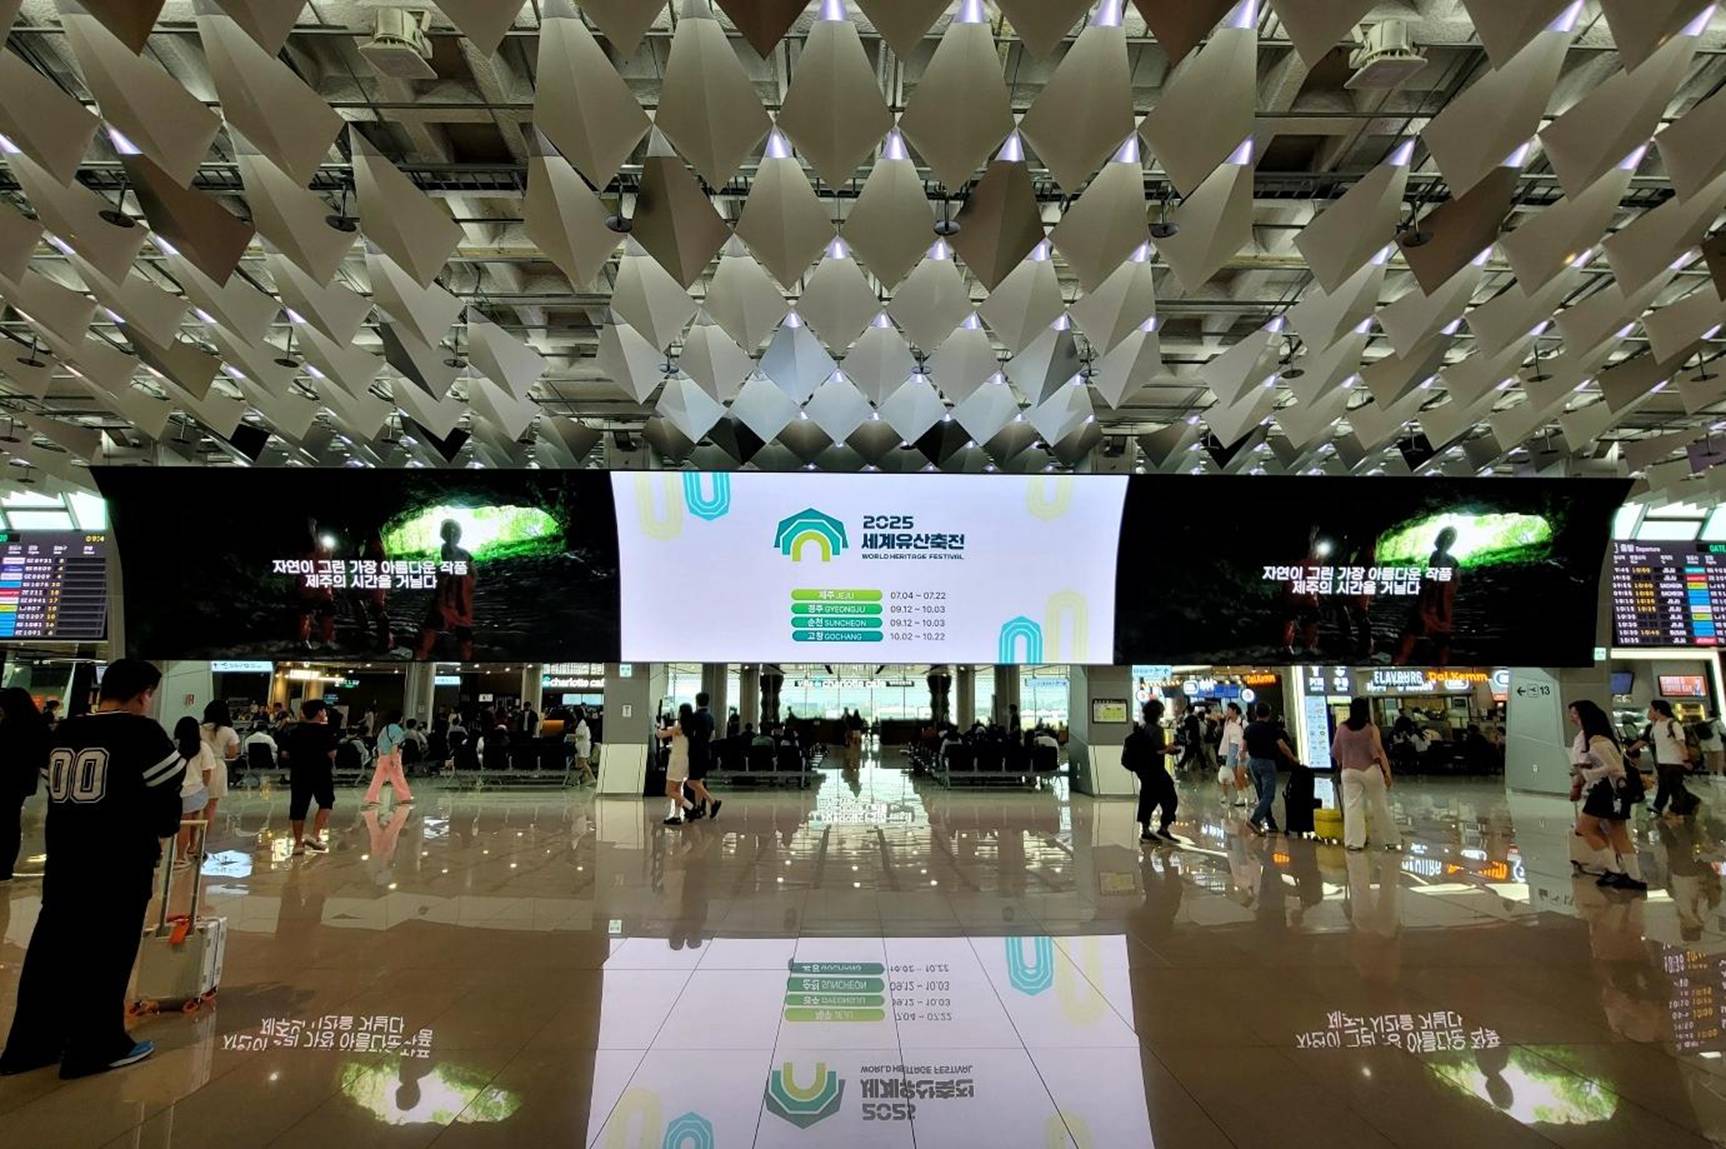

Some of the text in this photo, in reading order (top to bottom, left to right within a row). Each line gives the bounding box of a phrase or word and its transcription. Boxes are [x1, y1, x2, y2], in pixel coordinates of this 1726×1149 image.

[863, 515, 914, 529] 2025
[861, 533, 965, 550] 세계유산축전
[272, 560, 468, 575] 자연이 그린 가장 아름다운 작품
[1262, 566, 1452, 581] 자연이 그린 가장 아름다운 작품
[305, 575, 438, 589] 제주의 시간을 거닐다
[1292, 581, 1421, 595] 제주의 시간을 거닐다
[835, 592, 854, 600] JEJU
[890, 591, 914, 600] 07.04
[923, 591, 946, 600] 07.22
[824, 605, 866, 613] GYEONGJU
[890, 605, 913, 613] 09.12
[922, 605, 946, 613] 10.03
[824, 619, 867, 627] SUNCHEON
[890, 619, 913, 628] 09.12
[922, 619, 946, 628] 10.03
[824, 632, 863, 641] GOCHANG
[890, 632, 913, 641] 10.02
[922, 632, 946, 641] 10.22
[590, 677, 605, 688] caf
[1539, 685, 1551, 695] 13
[50, 747, 110, 803] 00
